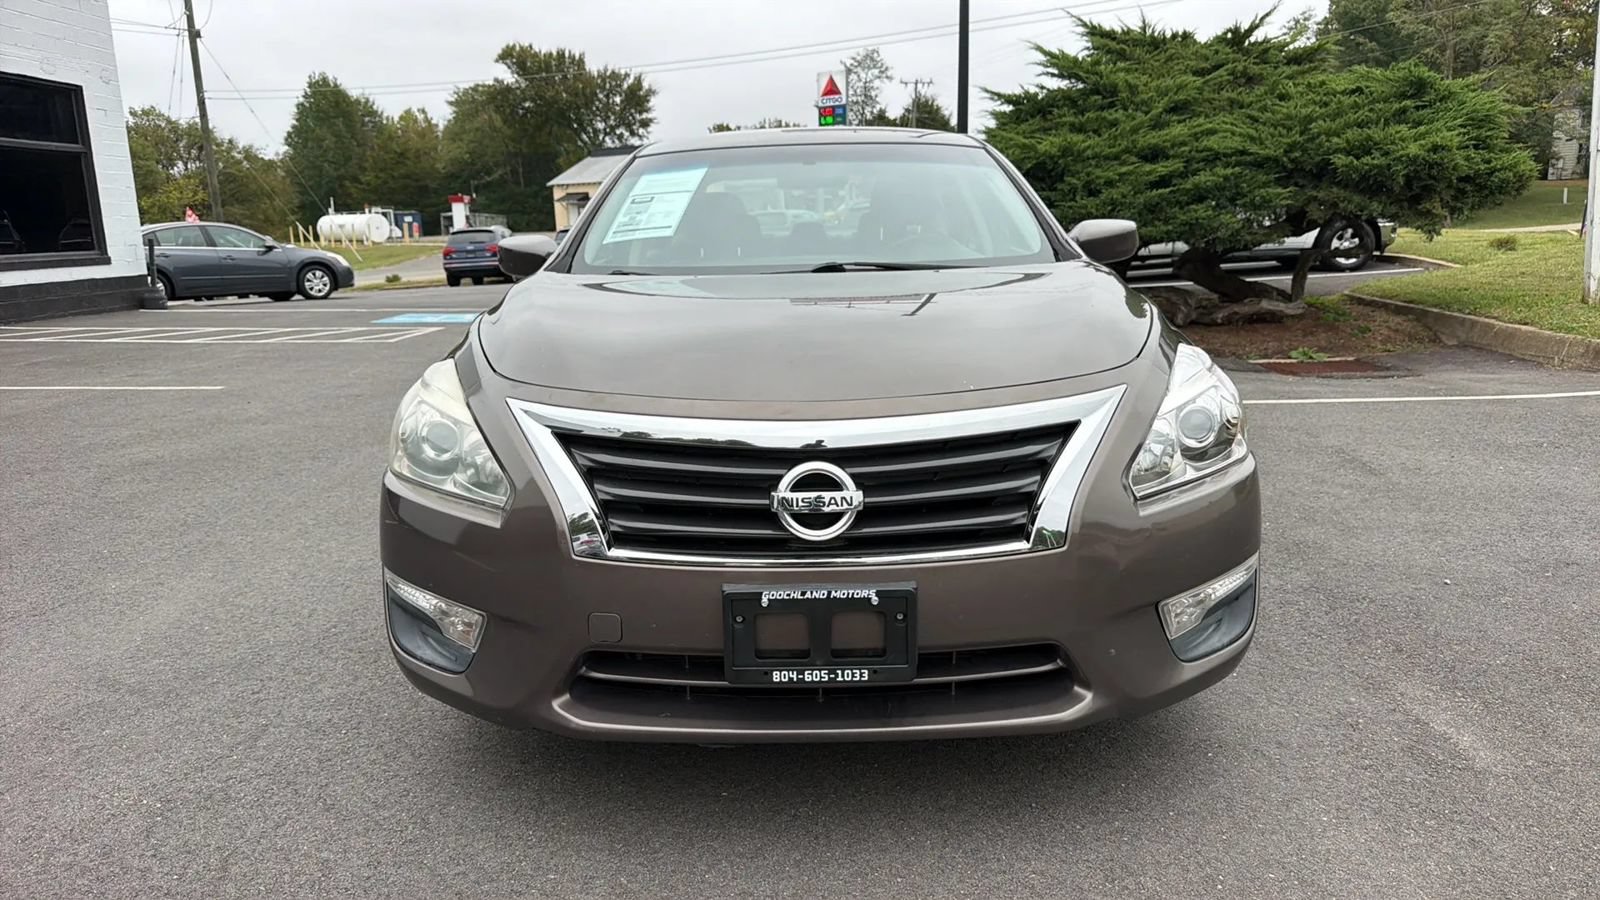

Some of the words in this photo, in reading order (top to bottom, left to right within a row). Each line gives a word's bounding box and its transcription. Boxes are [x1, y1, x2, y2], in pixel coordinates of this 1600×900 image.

[781, 496, 853, 508] NISSAN
[761, 591, 828, 599] GOOCHLAND
[830, 590, 876, 598] MOTORS
[772, 670, 869, 681] 804-605-1033
